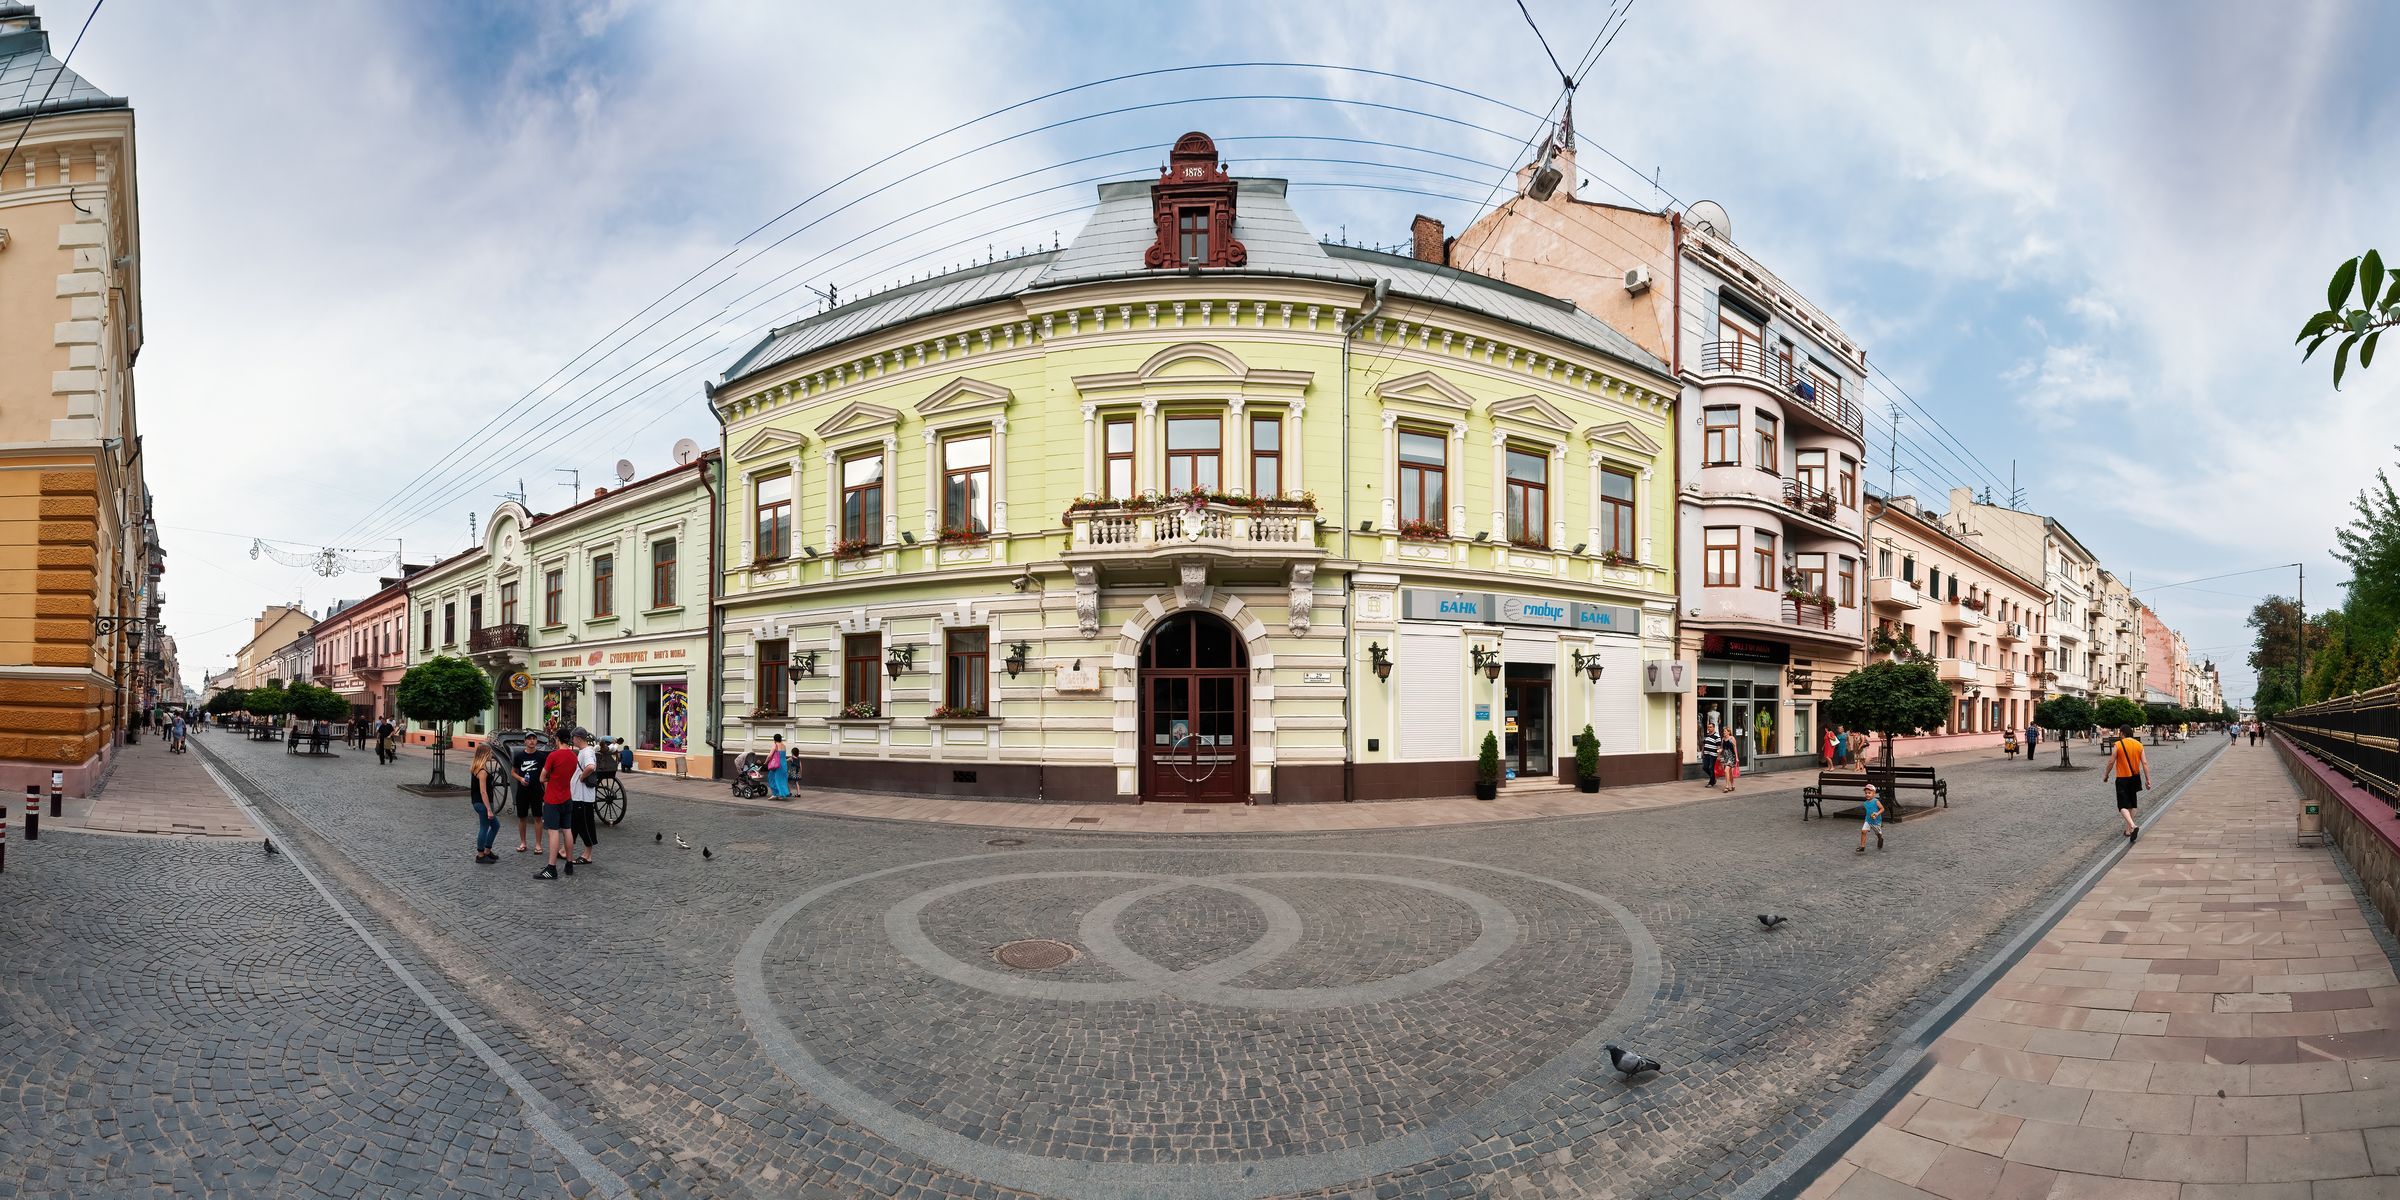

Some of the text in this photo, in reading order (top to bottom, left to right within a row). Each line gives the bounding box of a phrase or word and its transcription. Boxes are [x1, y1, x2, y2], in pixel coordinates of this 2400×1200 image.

[1184, 167, 1203, 177] 1878
[1440, 601, 1477, 615] БАНК
[1581, 612, 1611, 625] БАНК
